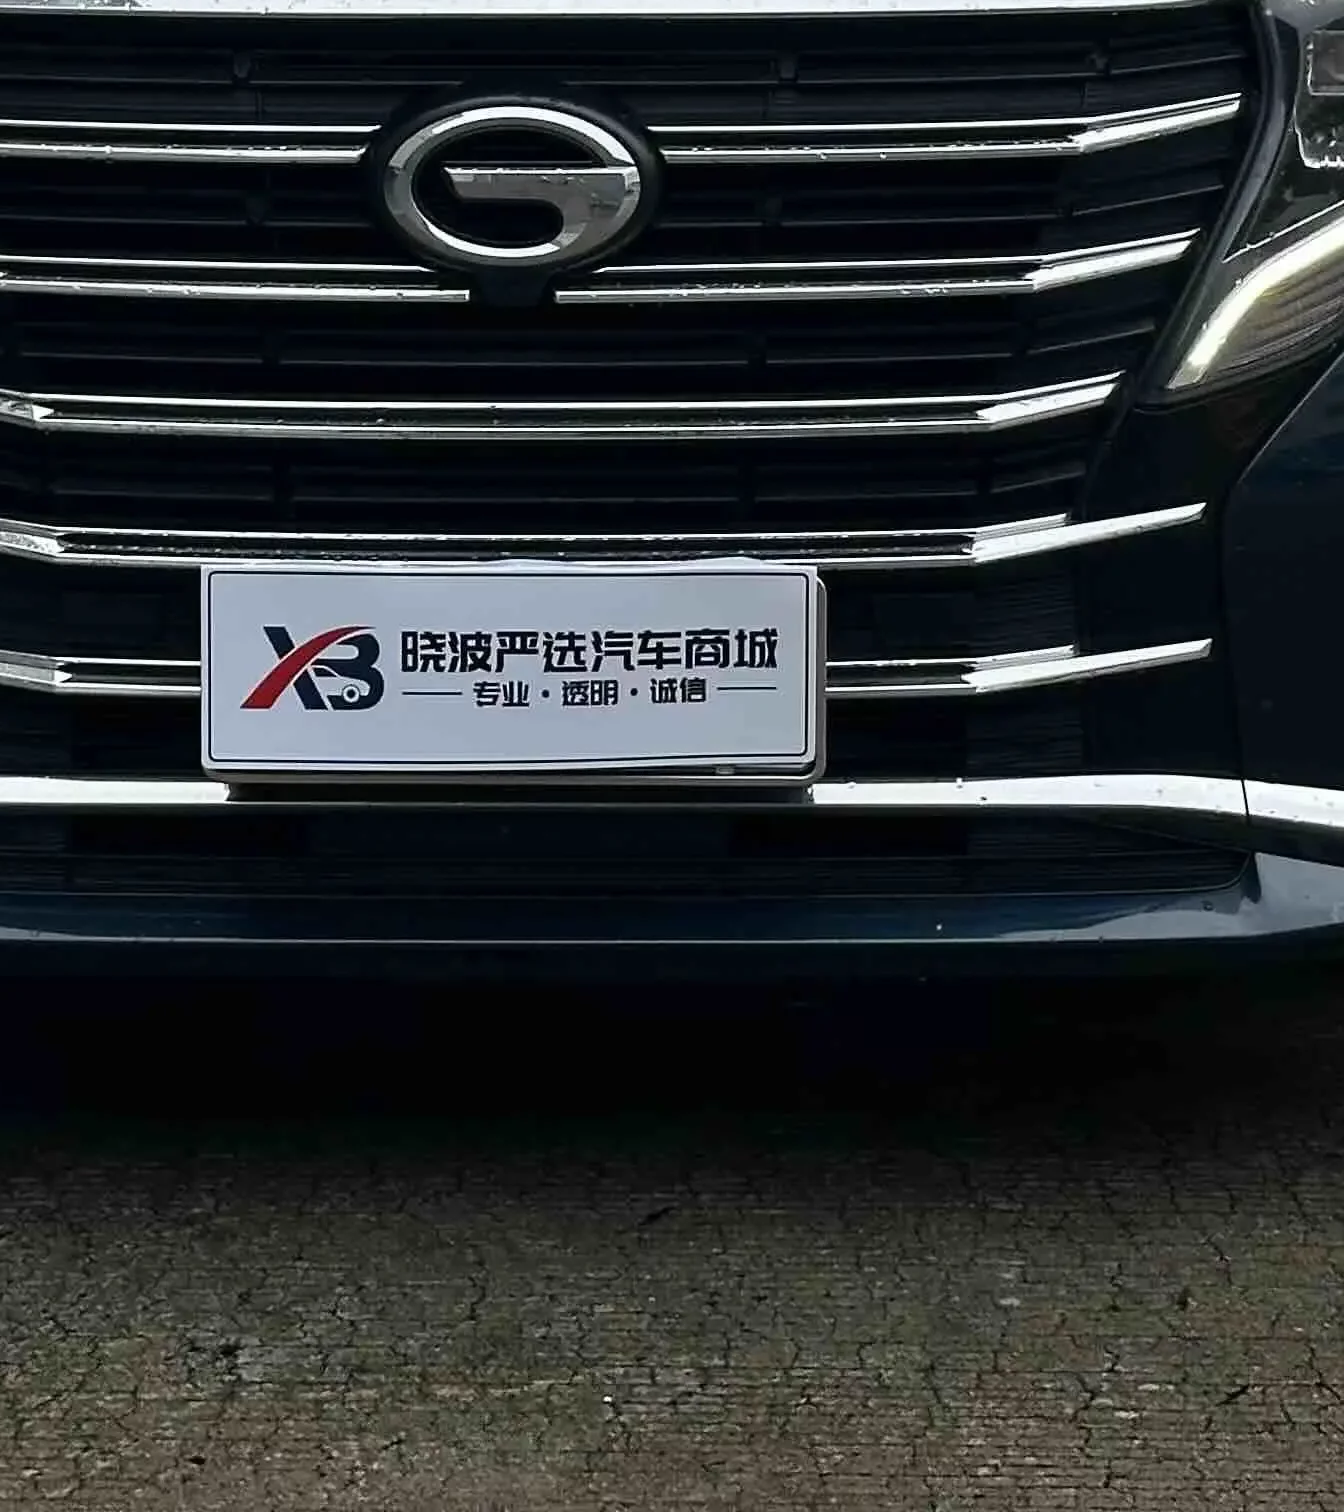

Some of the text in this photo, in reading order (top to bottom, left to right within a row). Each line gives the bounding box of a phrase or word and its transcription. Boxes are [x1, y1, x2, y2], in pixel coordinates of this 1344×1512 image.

[400, 628, 779, 673] 晓波严选汽车商城
